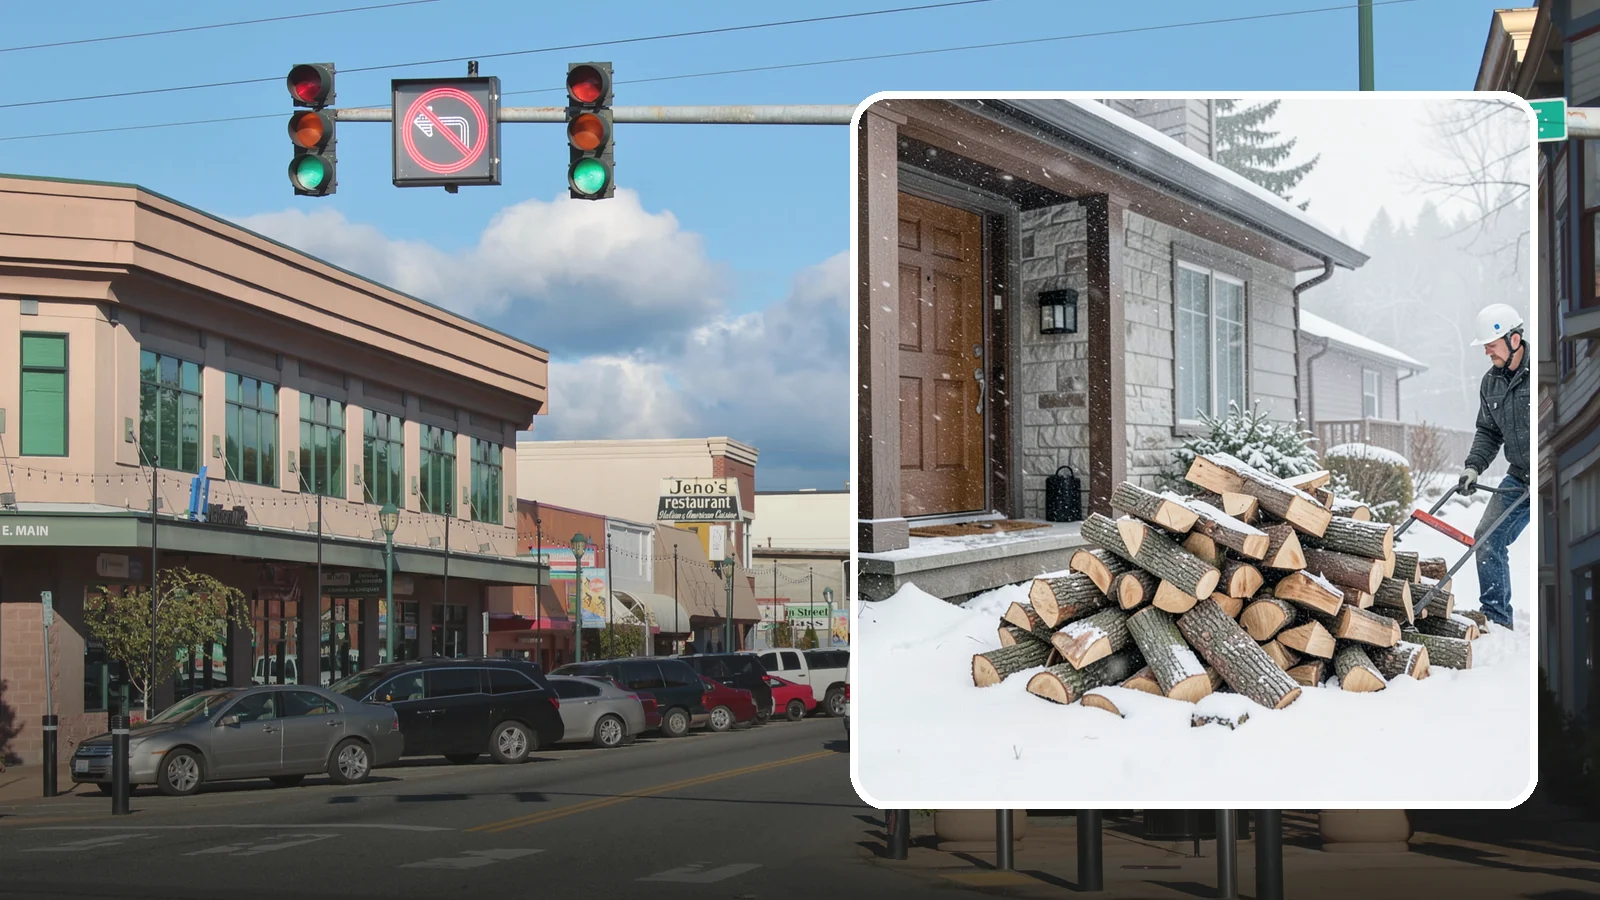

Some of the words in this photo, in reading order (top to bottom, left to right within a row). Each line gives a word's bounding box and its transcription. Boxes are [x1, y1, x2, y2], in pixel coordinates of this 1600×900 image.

[670, 480, 727, 494] Jeno's
[665, 497, 731, 509] restaurant
[658, 509, 682, 520] Italian
[686, 509, 715, 519] American
[715, 509, 738, 519] Cuisine
[2, 525, 13, 536] E.
[15, 525, 49, 536] MAIN
[797, 607, 829, 617] Street
